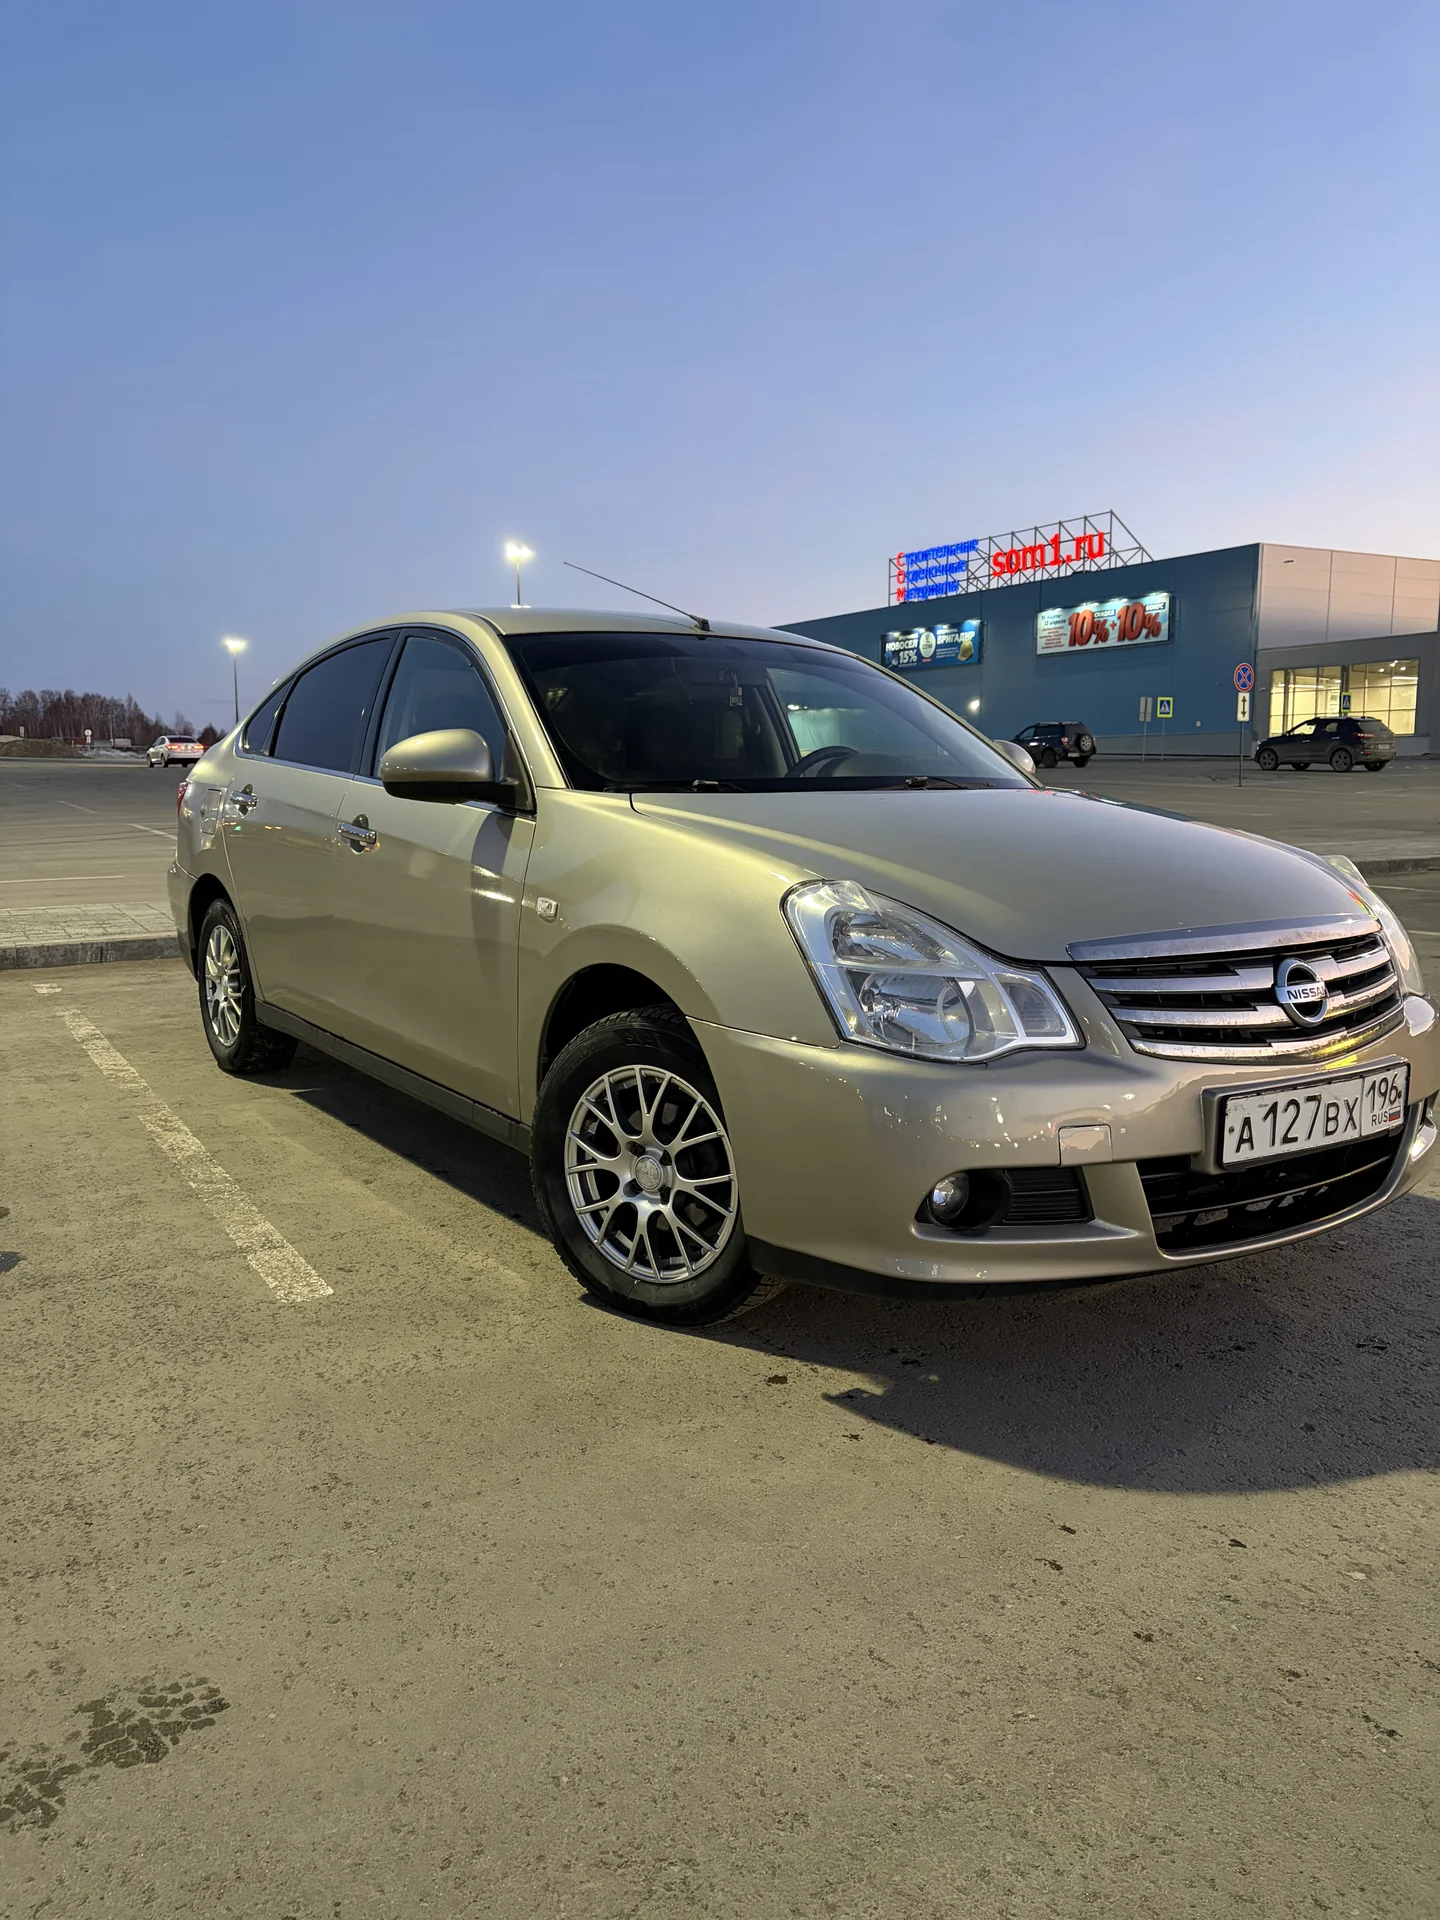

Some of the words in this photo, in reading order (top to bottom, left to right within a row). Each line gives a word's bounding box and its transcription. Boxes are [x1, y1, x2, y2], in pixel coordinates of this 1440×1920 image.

[896, 538, 979, 568] Строительные
[992, 532, 1105, 577] som1.ru
[896, 559, 967, 585] Отделочные
[896, 580, 960, 603] Материалы
[1068, 608, 1109, 647] 10%
[1117, 602, 1162, 643] 10%
[885, 639, 919, 652] НОВОСЕЛ
[936, 630, 976, 645] БРИГАДИР
[898, 649, 918, 664] 15%
[1286, 986, 1327, 1001] NISSAN
[1365, 1073, 1399, 1114] 196
[1371, 1111, 1389, 1126] RUS
